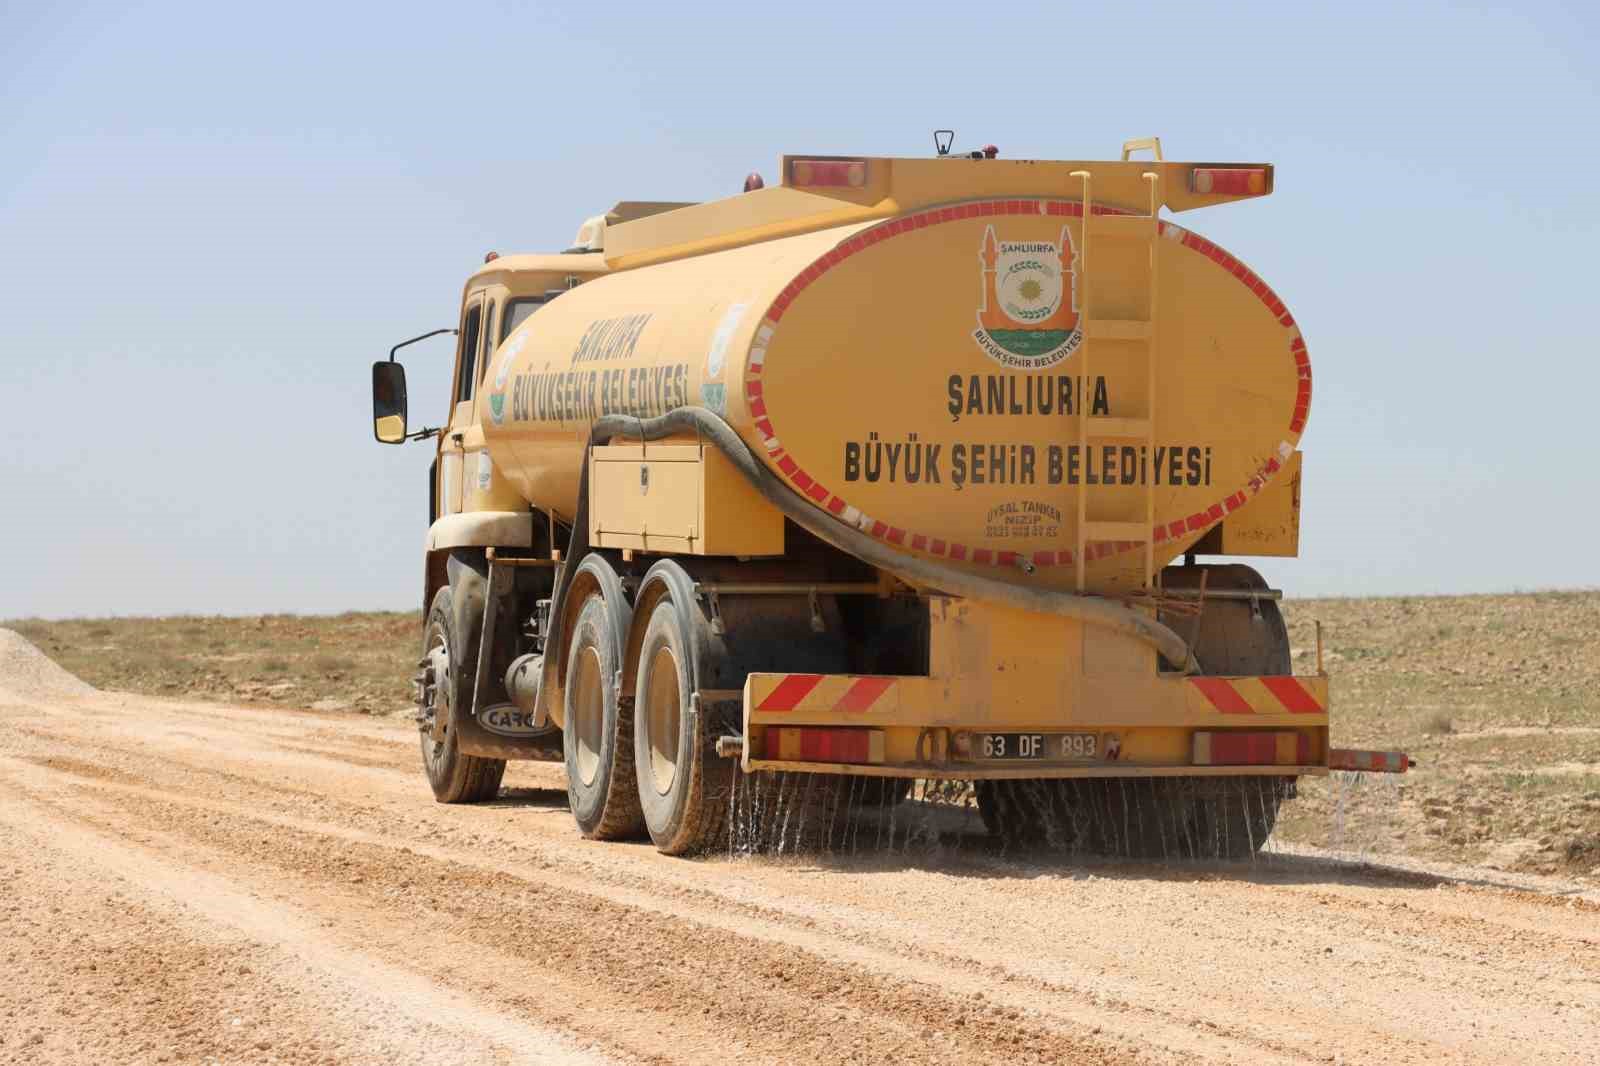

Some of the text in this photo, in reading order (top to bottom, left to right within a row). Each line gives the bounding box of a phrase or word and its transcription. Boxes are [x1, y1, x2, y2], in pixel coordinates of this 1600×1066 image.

[845, 432, 942, 484] BÜYÜK
[983, 735, 1096, 757] 63 DF 893
